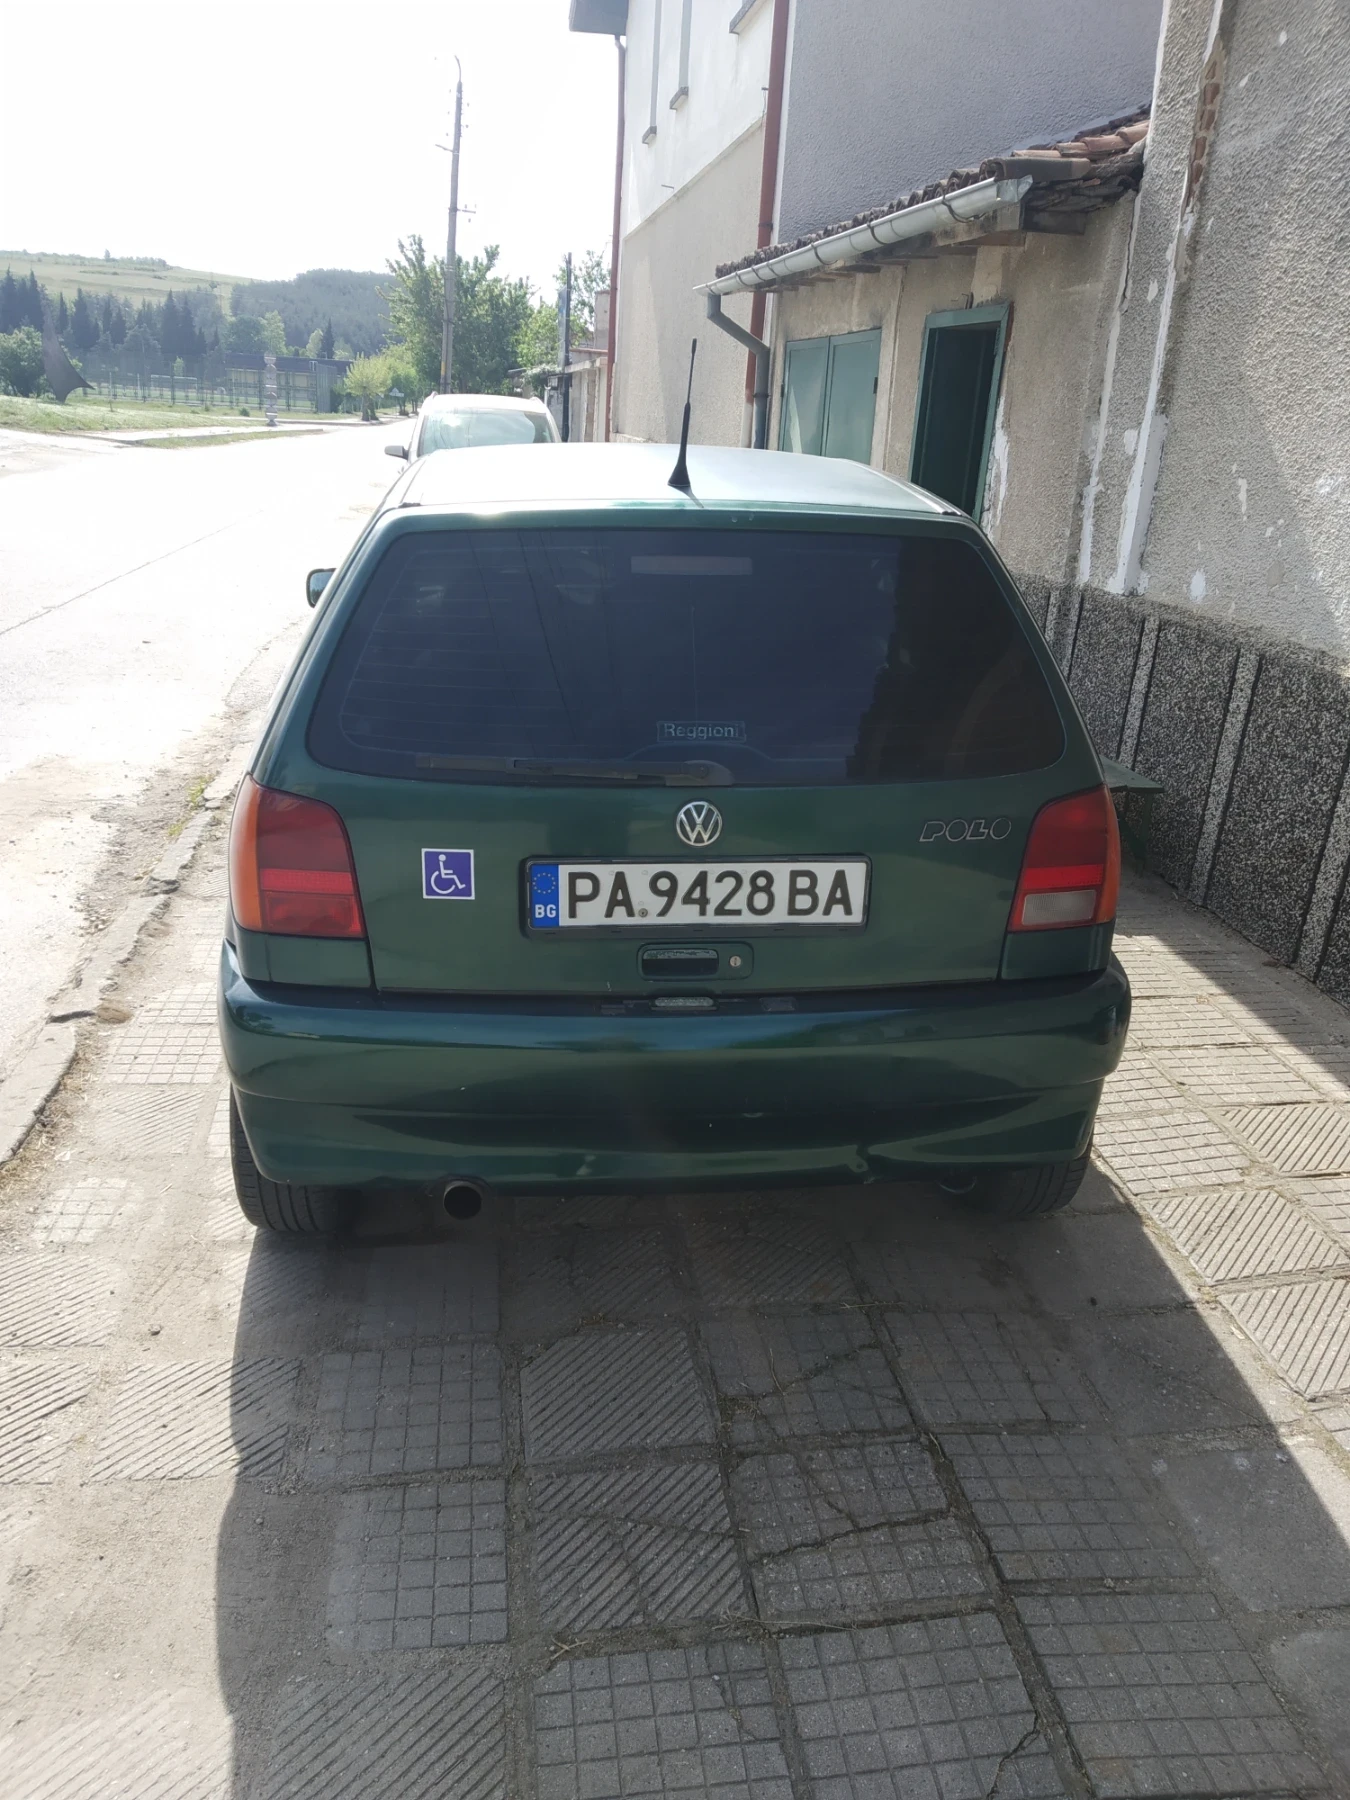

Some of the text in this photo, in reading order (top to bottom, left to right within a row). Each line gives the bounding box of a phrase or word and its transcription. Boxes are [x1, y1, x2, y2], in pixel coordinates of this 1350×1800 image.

[676, 801, 722, 846] VW
[919, 818, 1012, 842] POLO
[567, 869, 853, 919] PA 9428 BA
[535, 904, 557, 919] BG
